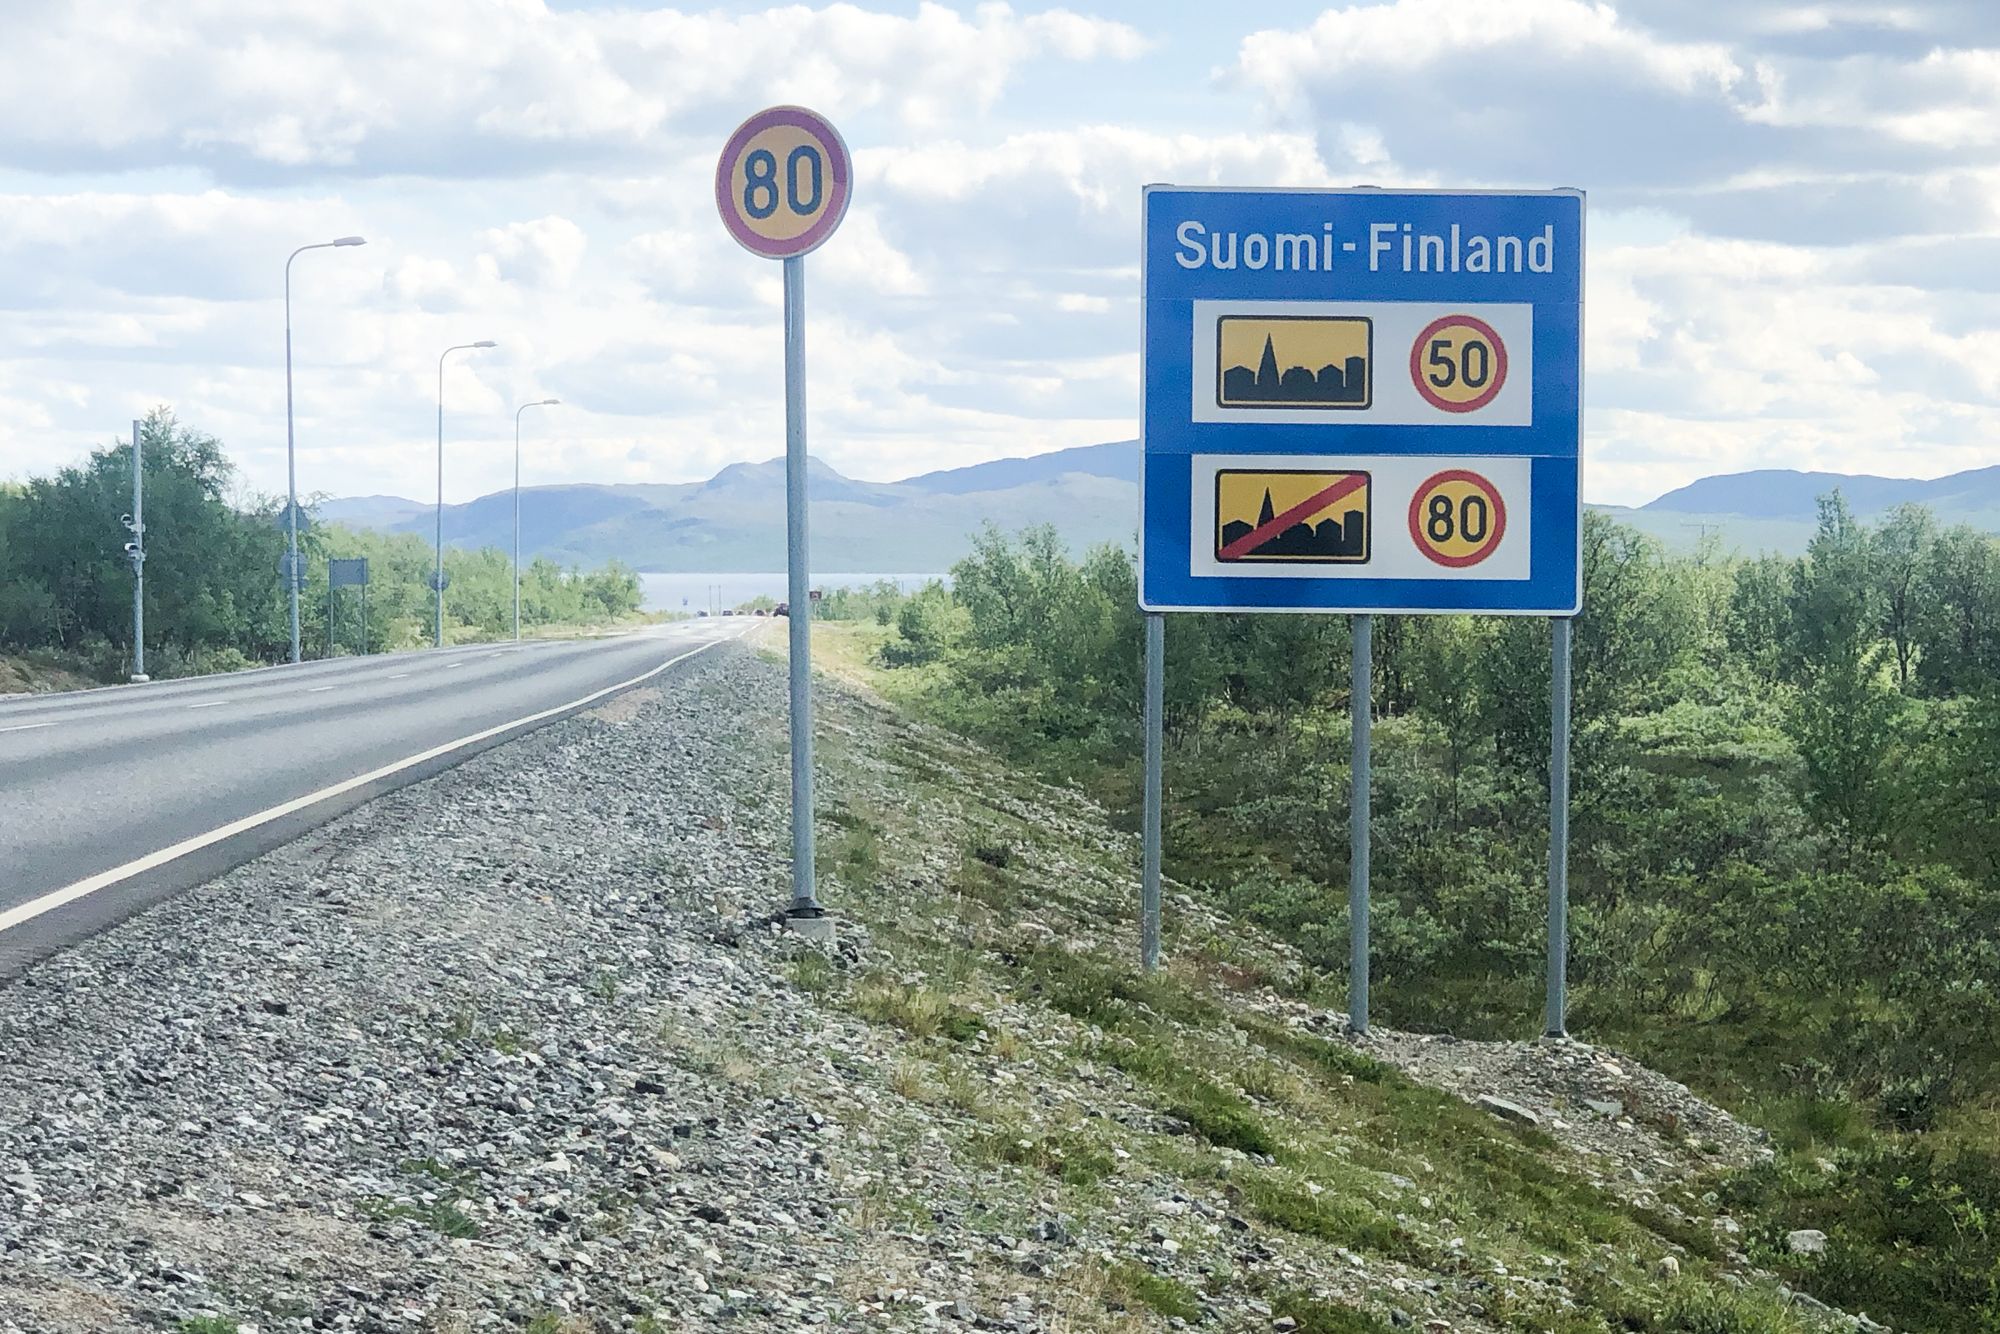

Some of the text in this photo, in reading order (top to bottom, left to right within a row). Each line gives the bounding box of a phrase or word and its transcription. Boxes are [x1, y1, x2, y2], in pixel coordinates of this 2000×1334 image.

[744, 145, 822, 219] 80
[1429, 340, 1488, 389] 50
[1427, 494, 1487, 543] 80
